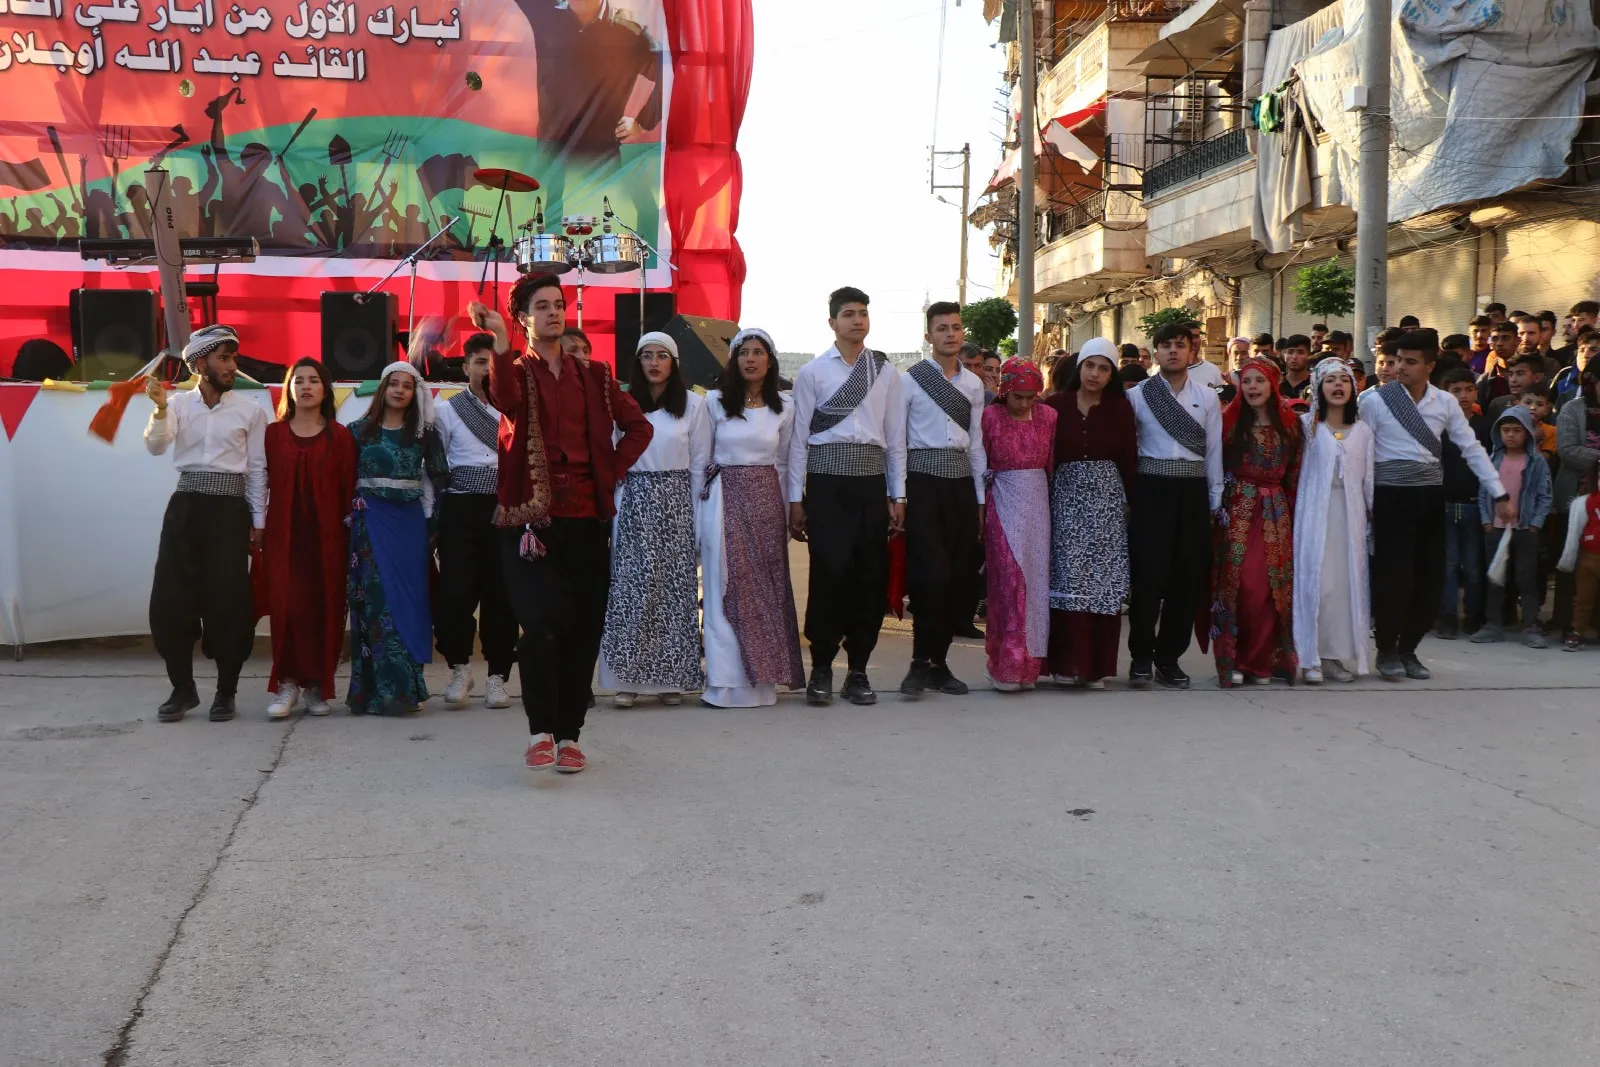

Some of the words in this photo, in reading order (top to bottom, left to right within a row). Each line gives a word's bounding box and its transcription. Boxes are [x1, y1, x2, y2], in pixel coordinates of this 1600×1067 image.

[74, 0, 140, 27] على
[224, 3, 272, 36] من
[285, 0, 356, 39] الأول
[366, 7, 461, 46] نبارك
[113, 38, 182, 73] الله
[192, 47, 261, 82] عبد
[272, 45, 366, 82] القائد
[166, 206, 175, 229] PRO
